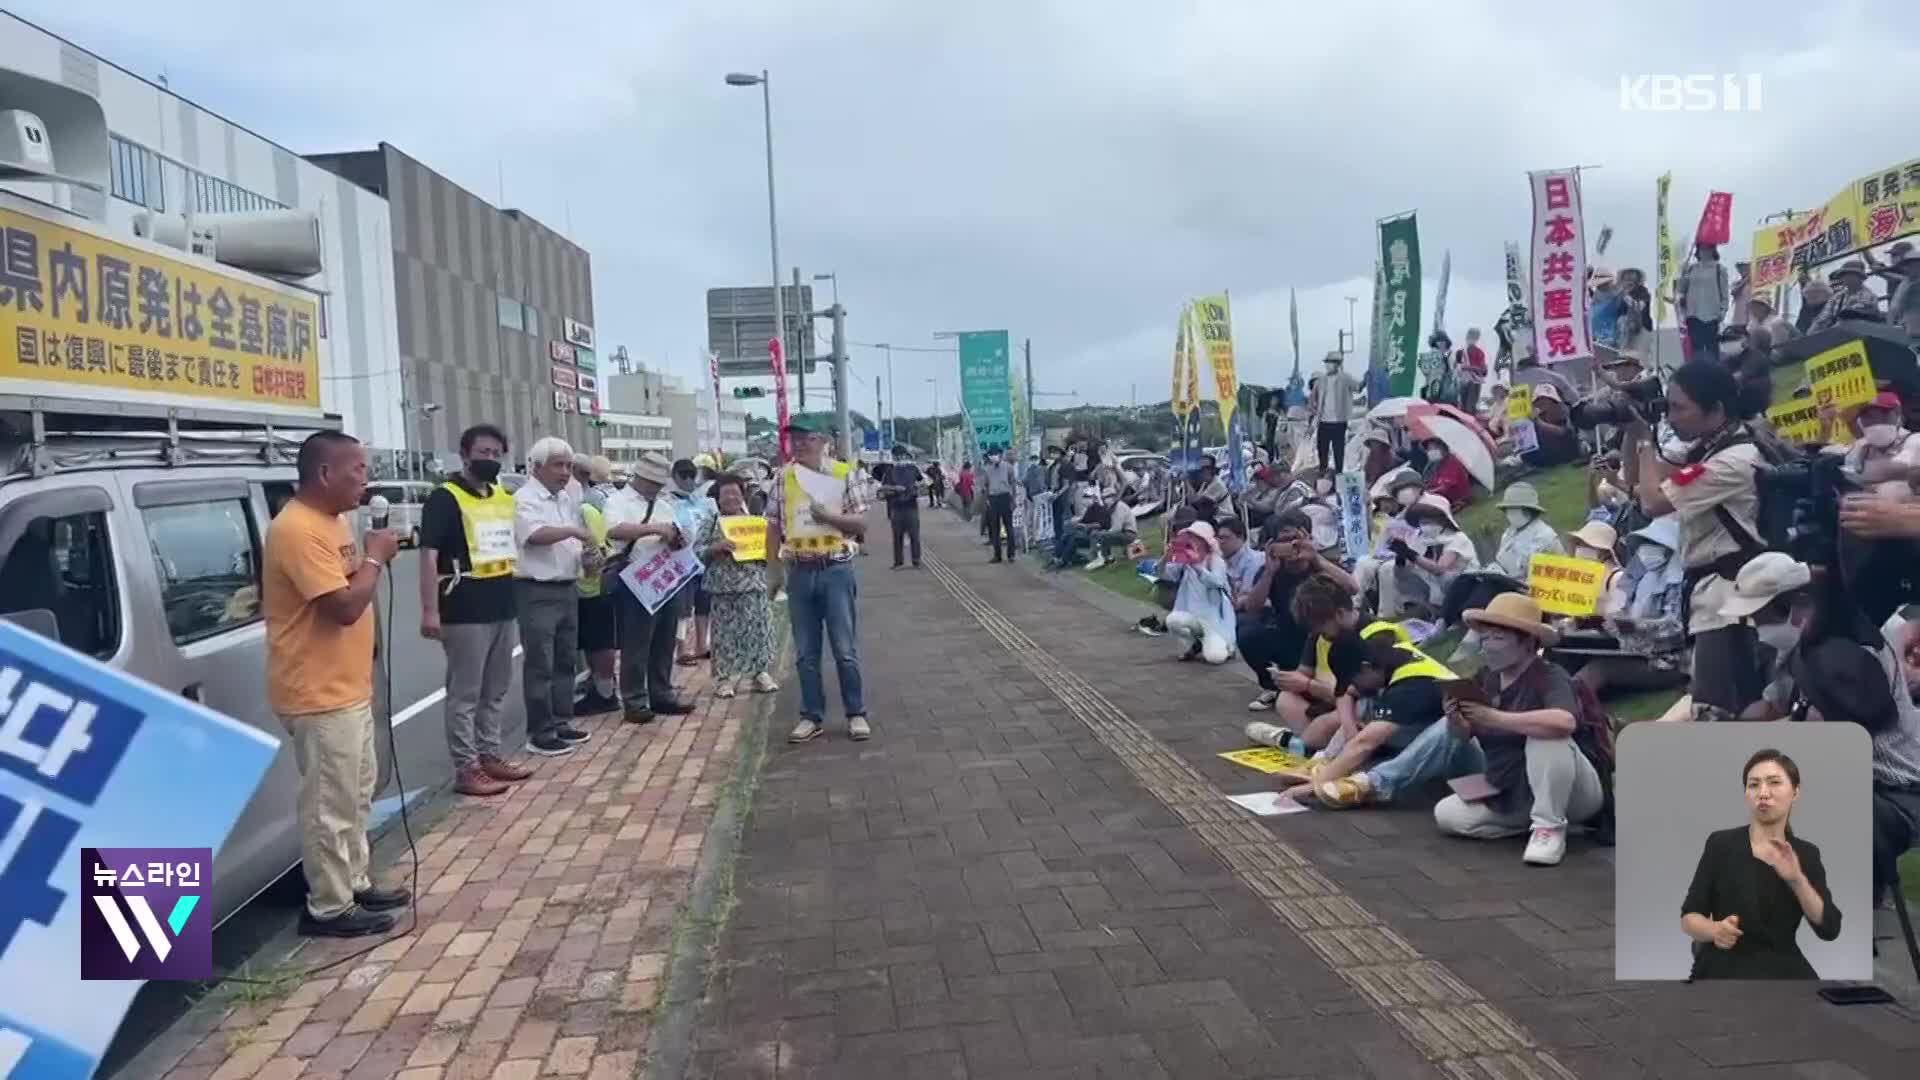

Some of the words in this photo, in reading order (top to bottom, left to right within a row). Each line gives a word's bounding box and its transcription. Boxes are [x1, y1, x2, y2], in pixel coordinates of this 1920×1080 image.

[0, 226, 311, 363] 県内原発は全基廃炉
[1543, 178, 1577, 357] 日本共産党
[16, 326, 241, 390] 国は復興に最後まで責任を
